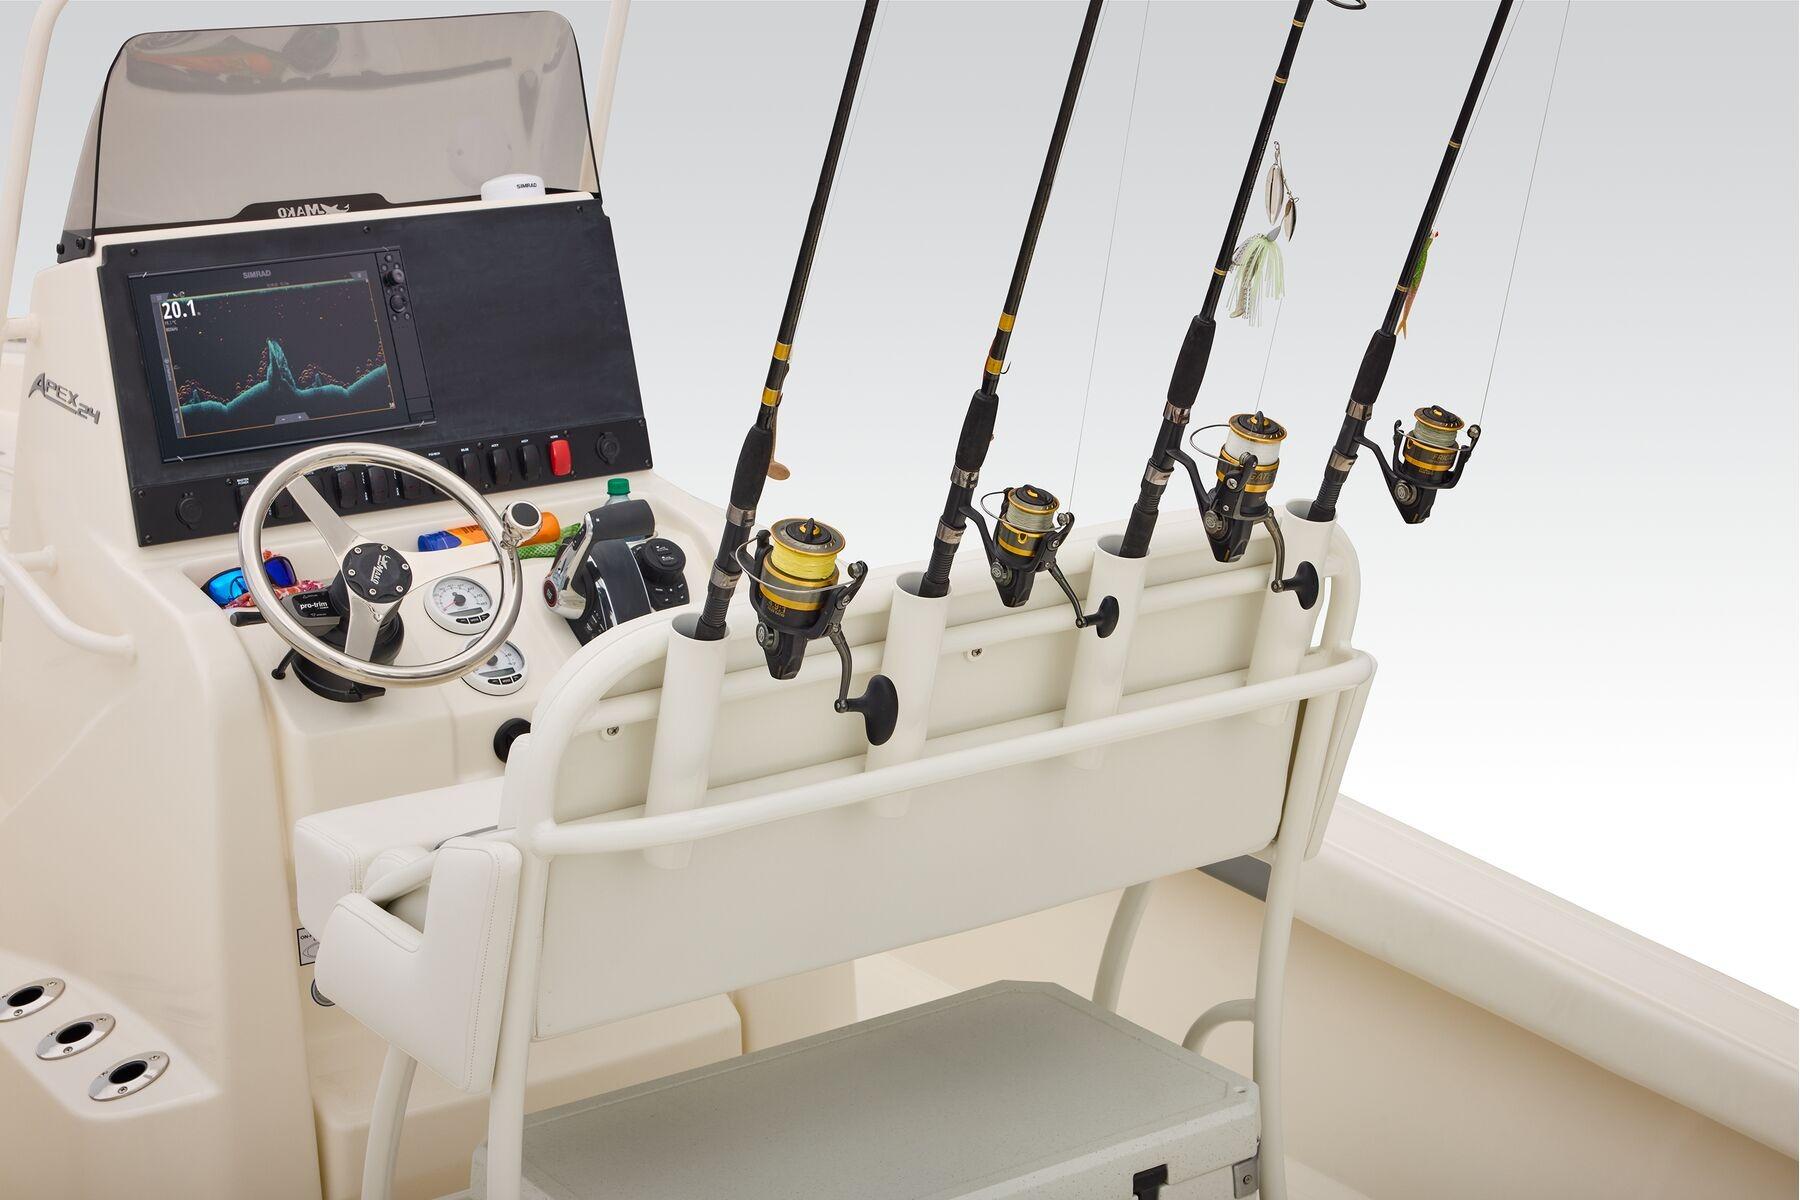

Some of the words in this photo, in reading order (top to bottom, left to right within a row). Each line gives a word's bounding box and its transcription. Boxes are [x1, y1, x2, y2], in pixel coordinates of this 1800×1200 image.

[242, 270, 271, 279] SIMRAD
[161, 299, 196, 320] 20.1
[27, 371, 79, 409] APEX
[77, 402, 101, 425] 24
[299, 600, 328, 610] pro-trim
